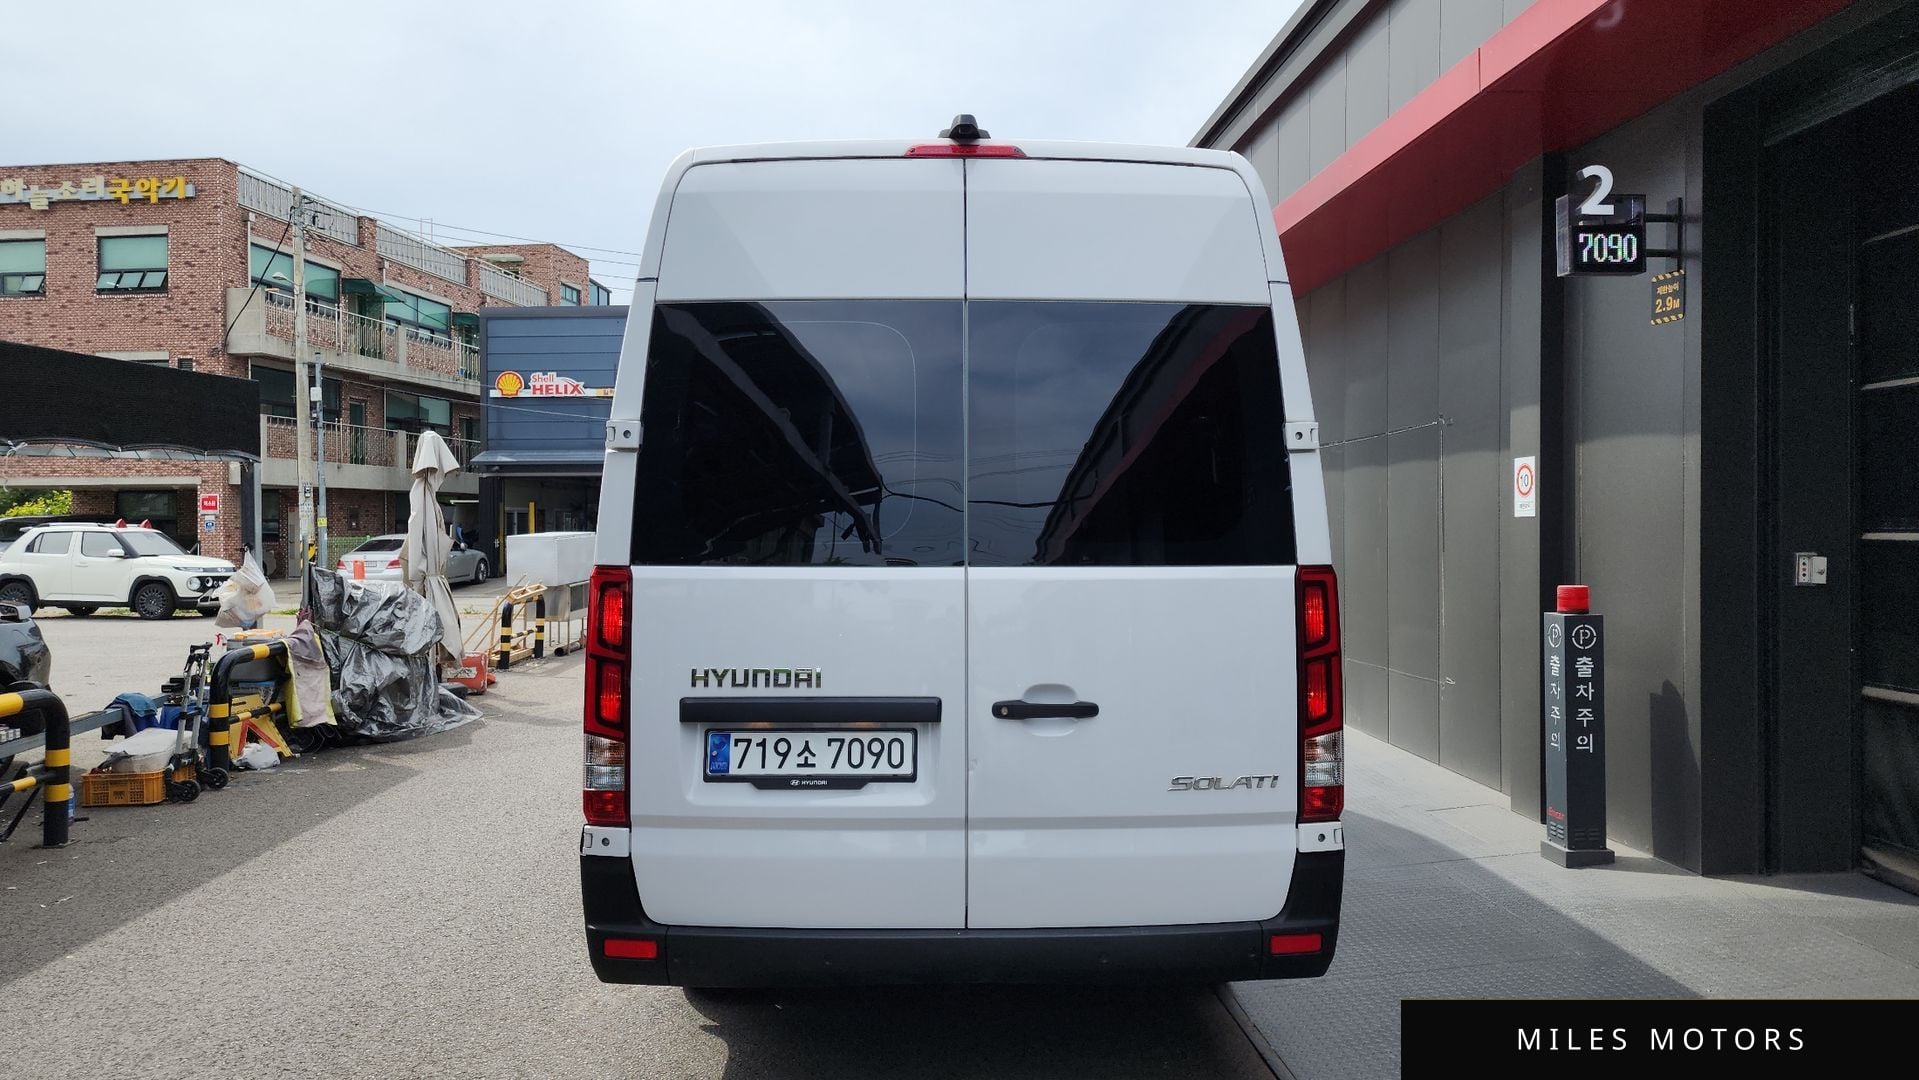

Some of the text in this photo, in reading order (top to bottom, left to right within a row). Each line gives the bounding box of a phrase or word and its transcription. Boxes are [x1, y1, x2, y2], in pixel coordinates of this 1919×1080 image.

[108, 175, 186, 204] 국악기
[1580, 164, 1615, 216] 2
[1579, 233, 1637, 263] 7090
[532, 374, 554, 383] Shell
[532, 384, 585, 395] HELIX
[690, 667, 822, 688] HYUNDAI
[1550, 655, 1561, 752] 출차주의
[1574, 656, 1595, 753] 출차주의
[733, 737, 905, 769] 719소 7090
[1167, 774, 1280, 792] SOLATI
